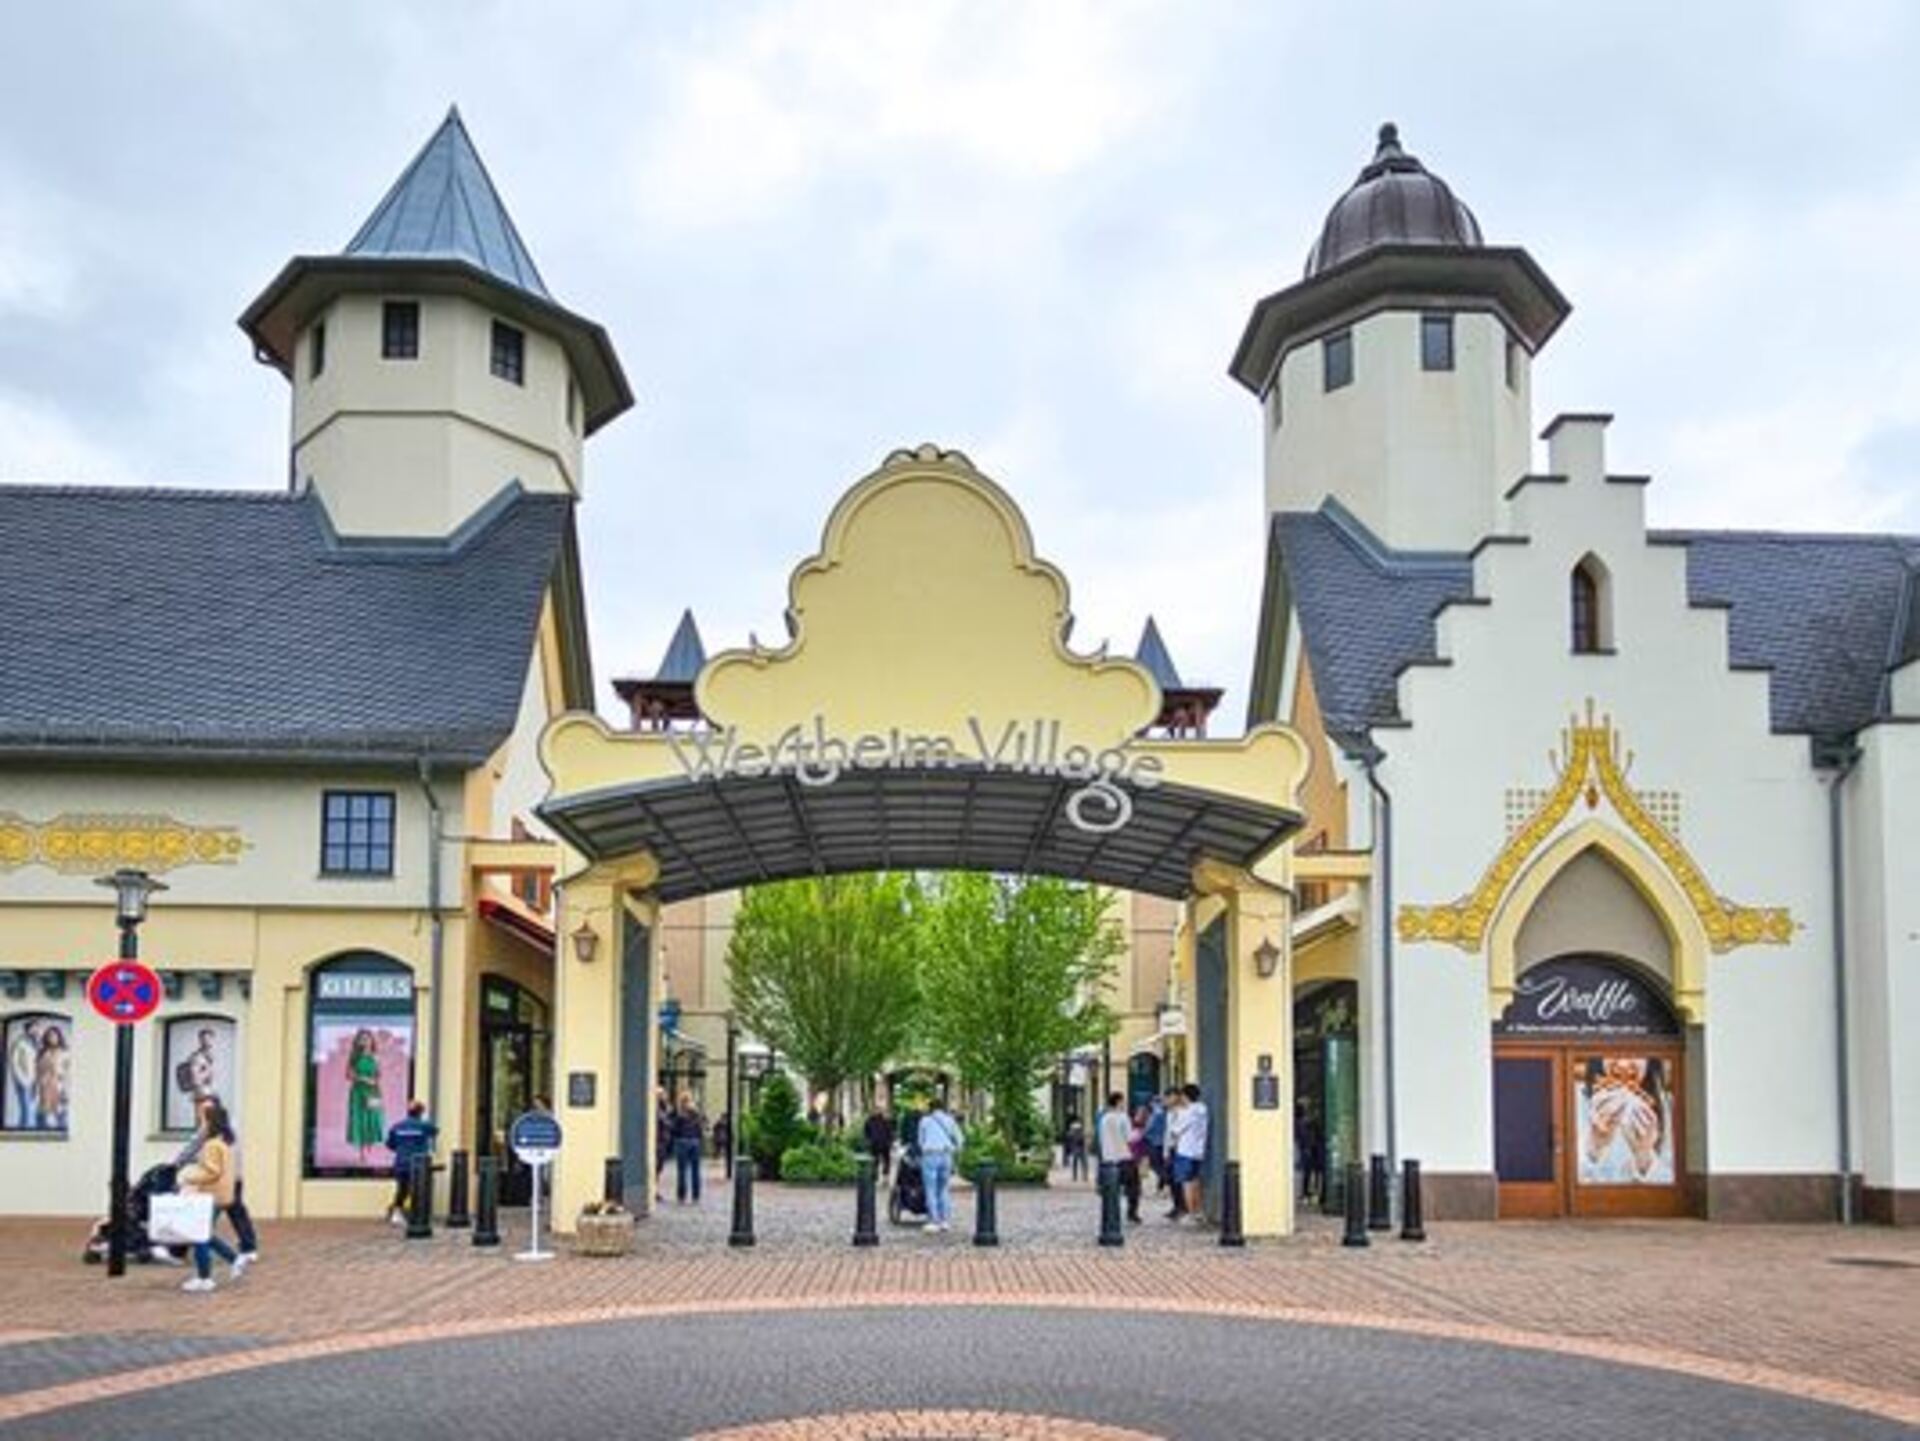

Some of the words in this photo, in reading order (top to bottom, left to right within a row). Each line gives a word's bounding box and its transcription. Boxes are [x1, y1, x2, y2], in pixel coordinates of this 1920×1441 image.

[665, 715, 956, 786] Wertheim
[967, 717, 1163, 832] Village
[321, 975, 411, 998] GUESS
